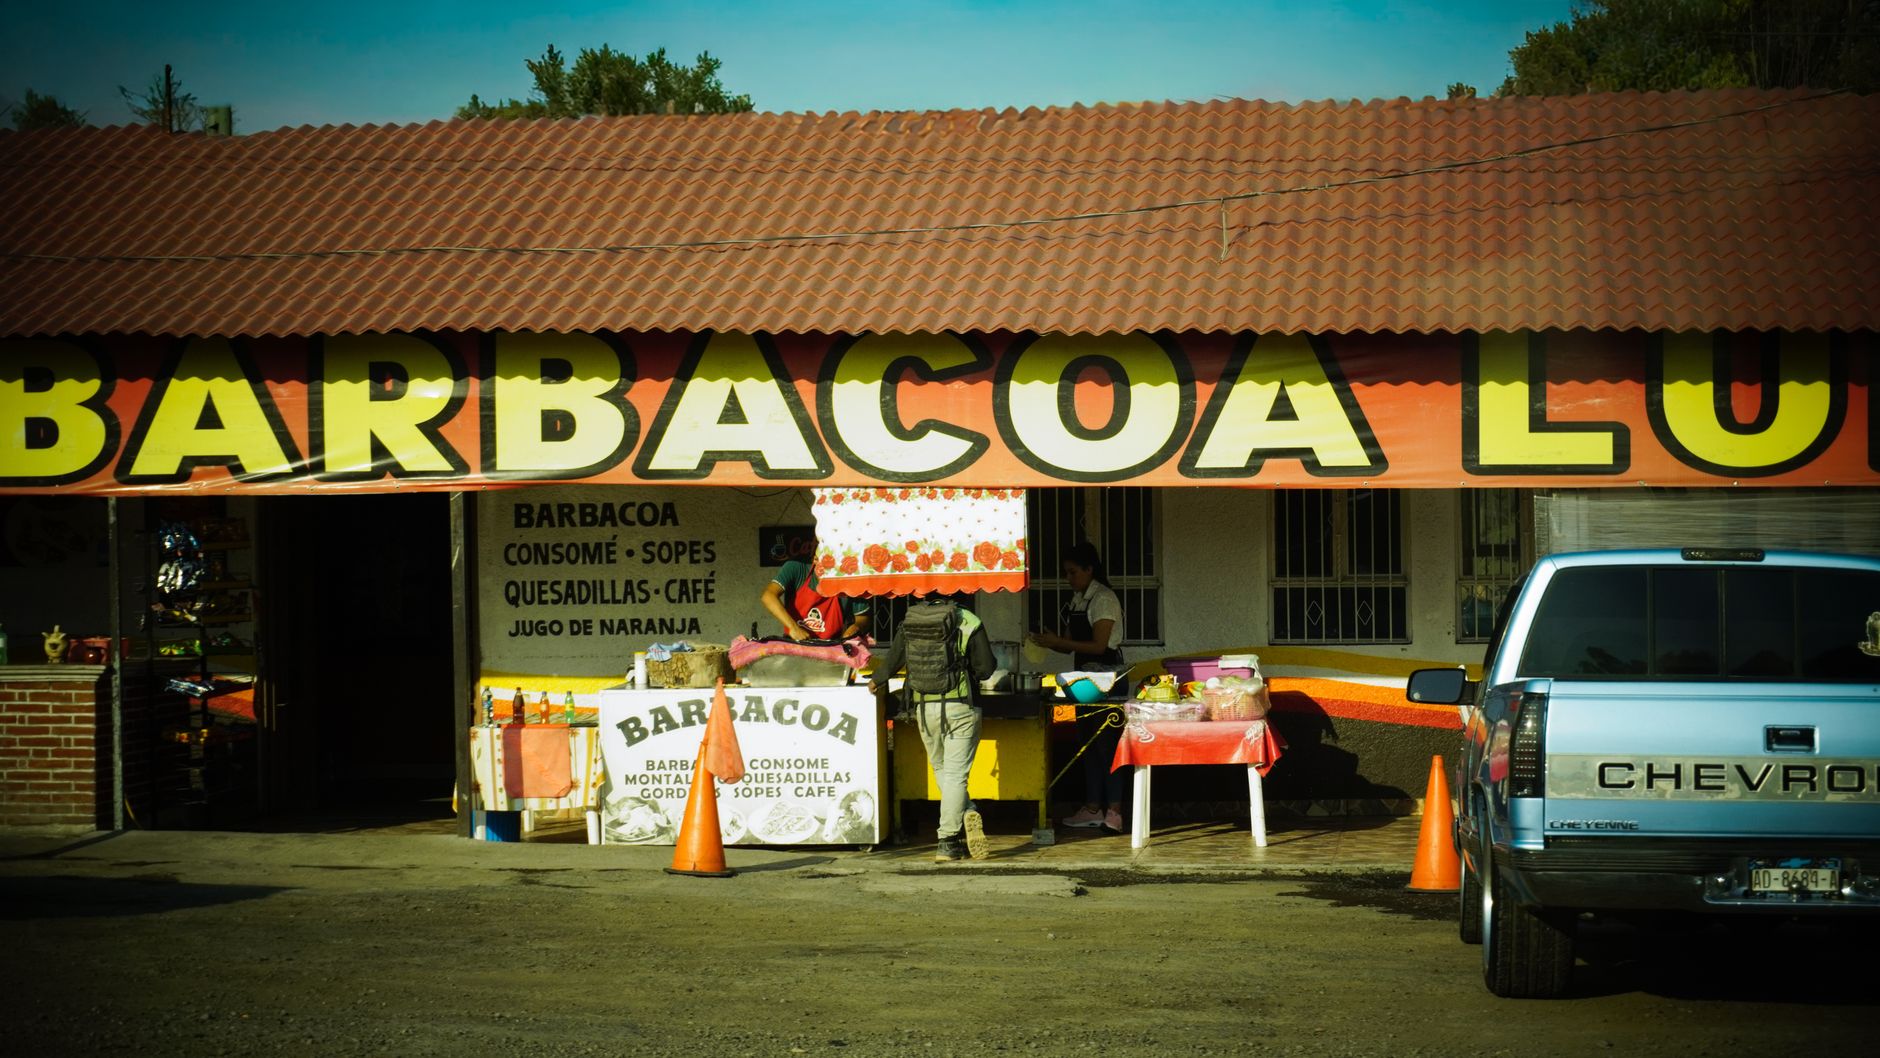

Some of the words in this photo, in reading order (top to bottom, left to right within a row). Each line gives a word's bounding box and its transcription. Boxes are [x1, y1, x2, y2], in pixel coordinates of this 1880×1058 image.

[0, 329, 1387, 484] BARBACOA
[1462, 329, 1880, 482] LU
[514, 502, 679, 528] BARBACOA
[504, 537, 617, 565] CONSOMÉ
[643, 541, 717, 564] SOPES
[504, 580, 650, 607] QUESADILLAS
[665, 572, 716, 604] CAFÉ
[508, 620, 563, 637] JUGO
[570, 620, 593, 636] DE
[600, 618, 701, 636] NARANJA
[749, 758, 829, 770] CONSOME
[743, 772, 851, 786] QUESADILLAS
[734, 786, 781, 799] SOPES
[794, 786, 836, 798] CAFE
[1549, 820, 1640, 831] CHEYENNE
